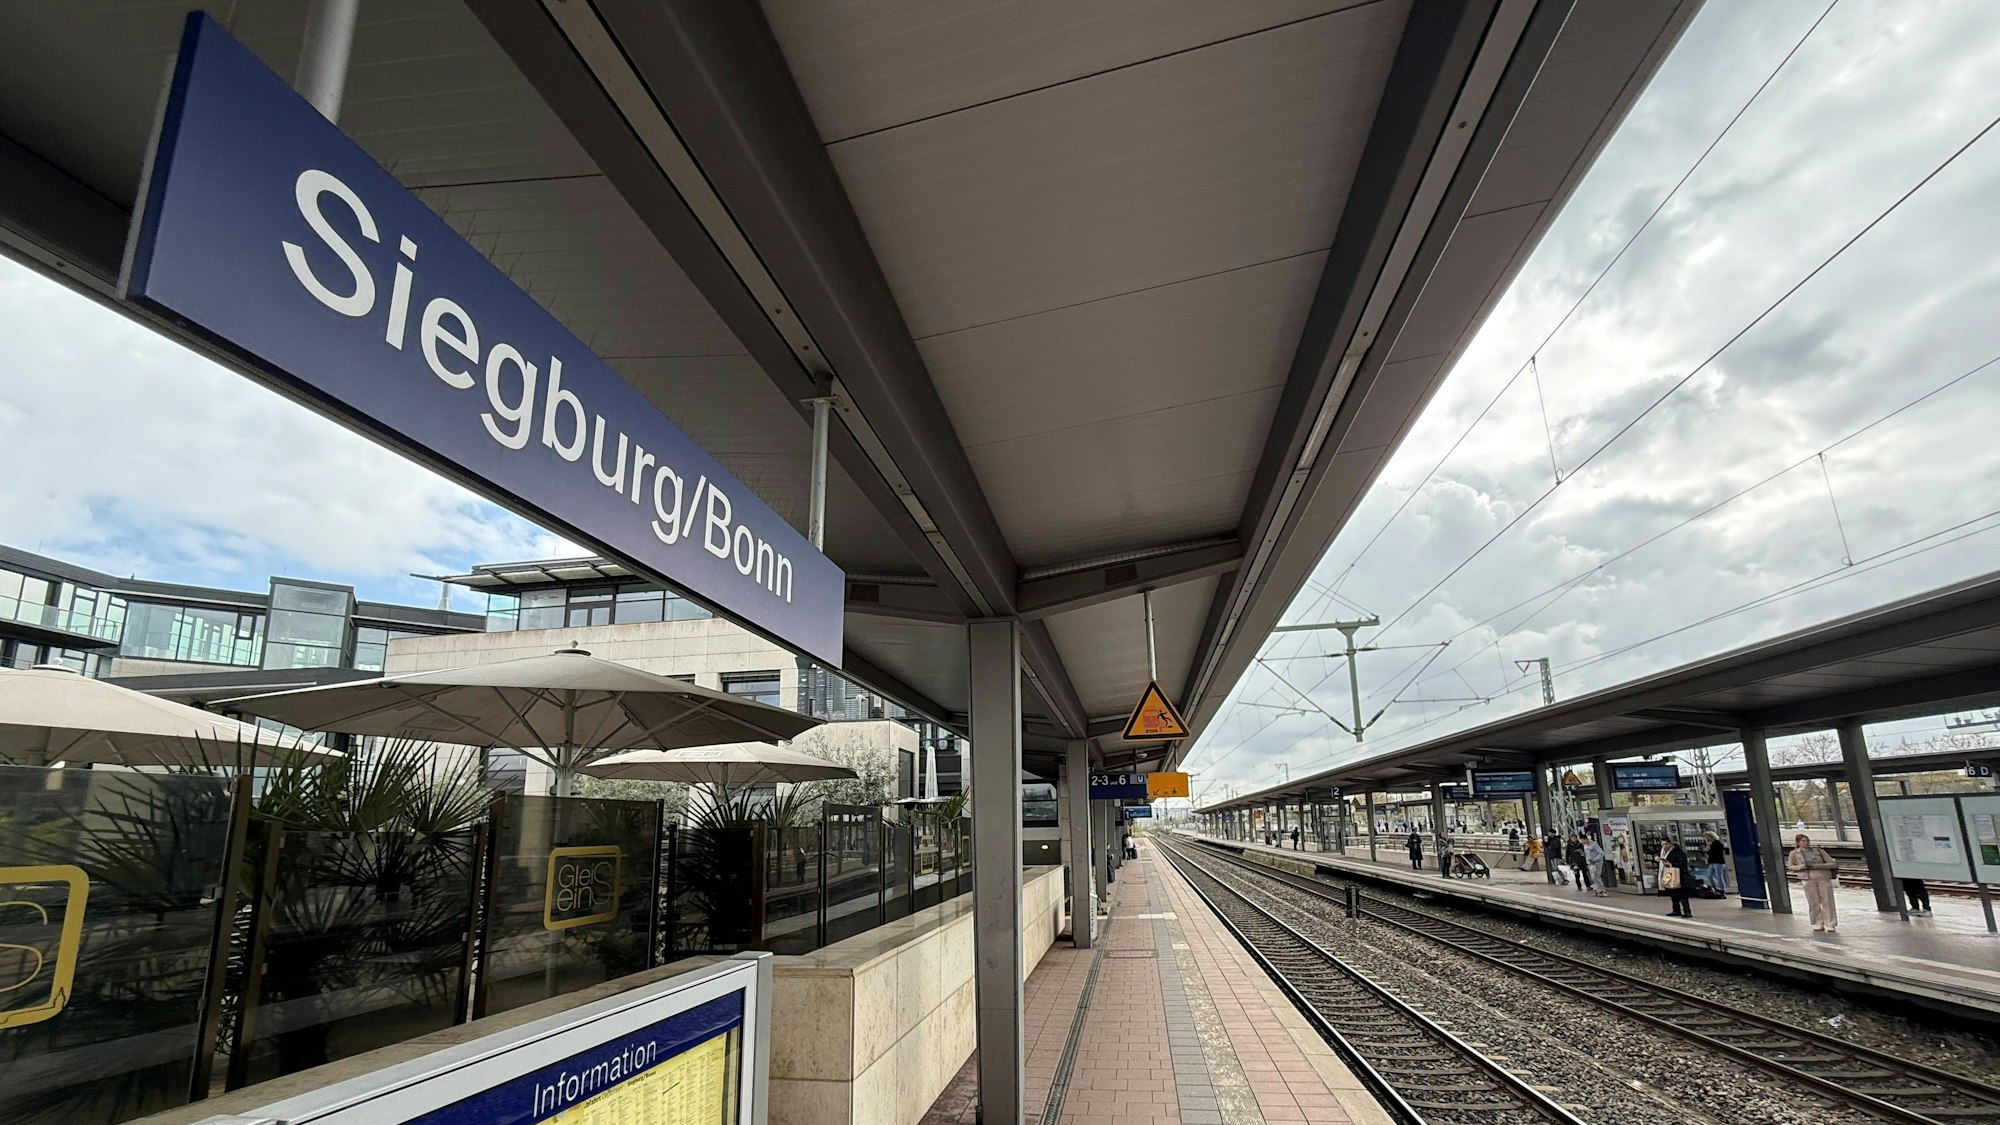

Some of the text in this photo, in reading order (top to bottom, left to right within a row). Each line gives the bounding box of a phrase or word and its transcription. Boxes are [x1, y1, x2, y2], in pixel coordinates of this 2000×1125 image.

[281, 169, 793, 604] Siegburg/Bonn
[1968, 766, 1989, 776] 6 D
[1091, 775, 1109, 786] 2-3
[1119, 774, 1126, 785] 6
[1137, 775, 1144, 783] U
[1333, 787, 1340, 796] 2
[533, 1040, 657, 1118] Information
